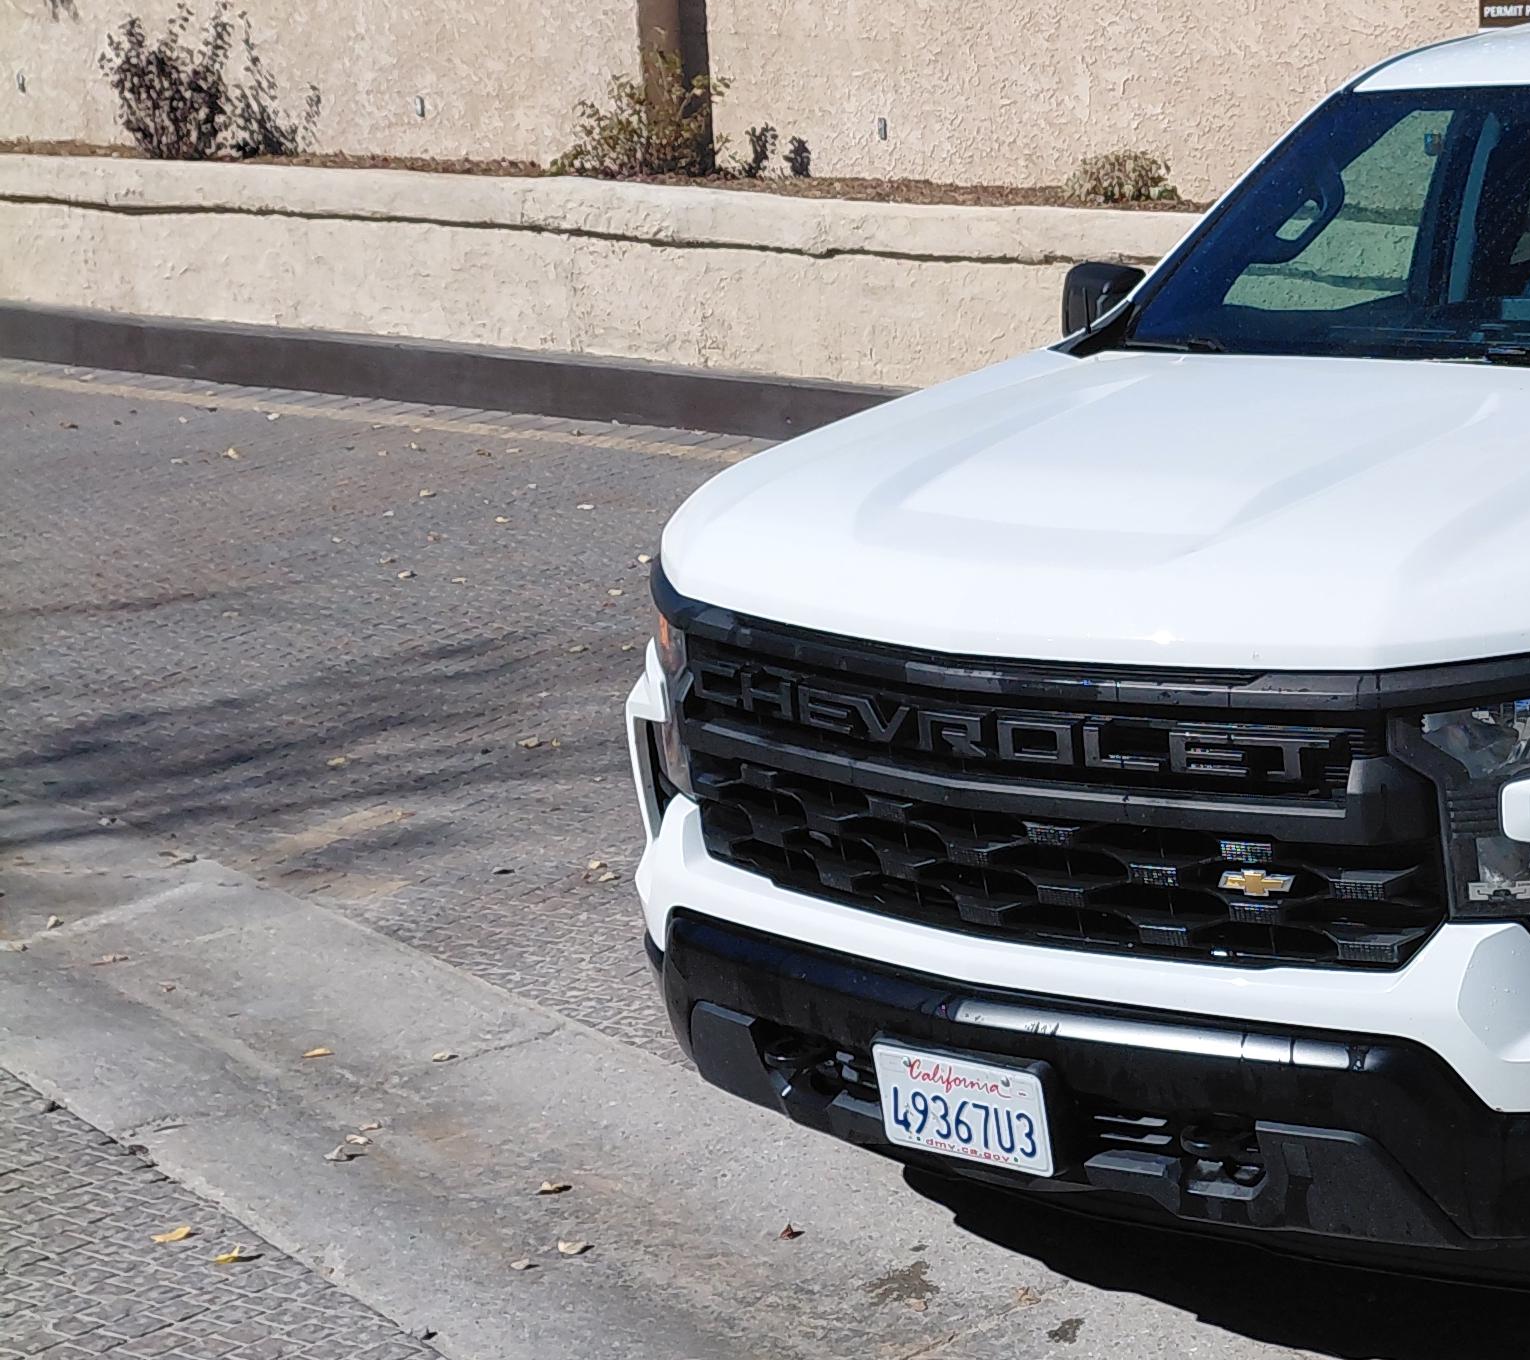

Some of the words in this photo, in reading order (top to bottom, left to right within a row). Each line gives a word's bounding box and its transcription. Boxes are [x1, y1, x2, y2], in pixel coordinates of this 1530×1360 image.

[1484, 5, 1524, 18] PERMIT
[692, 659, 1333, 781] CHEVROLET
[908, 1058, 1012, 1099] California
[892, 1086, 1037, 1158] 49367U3
[925, 1137, 1010, 1164] dmv.ca.gov
